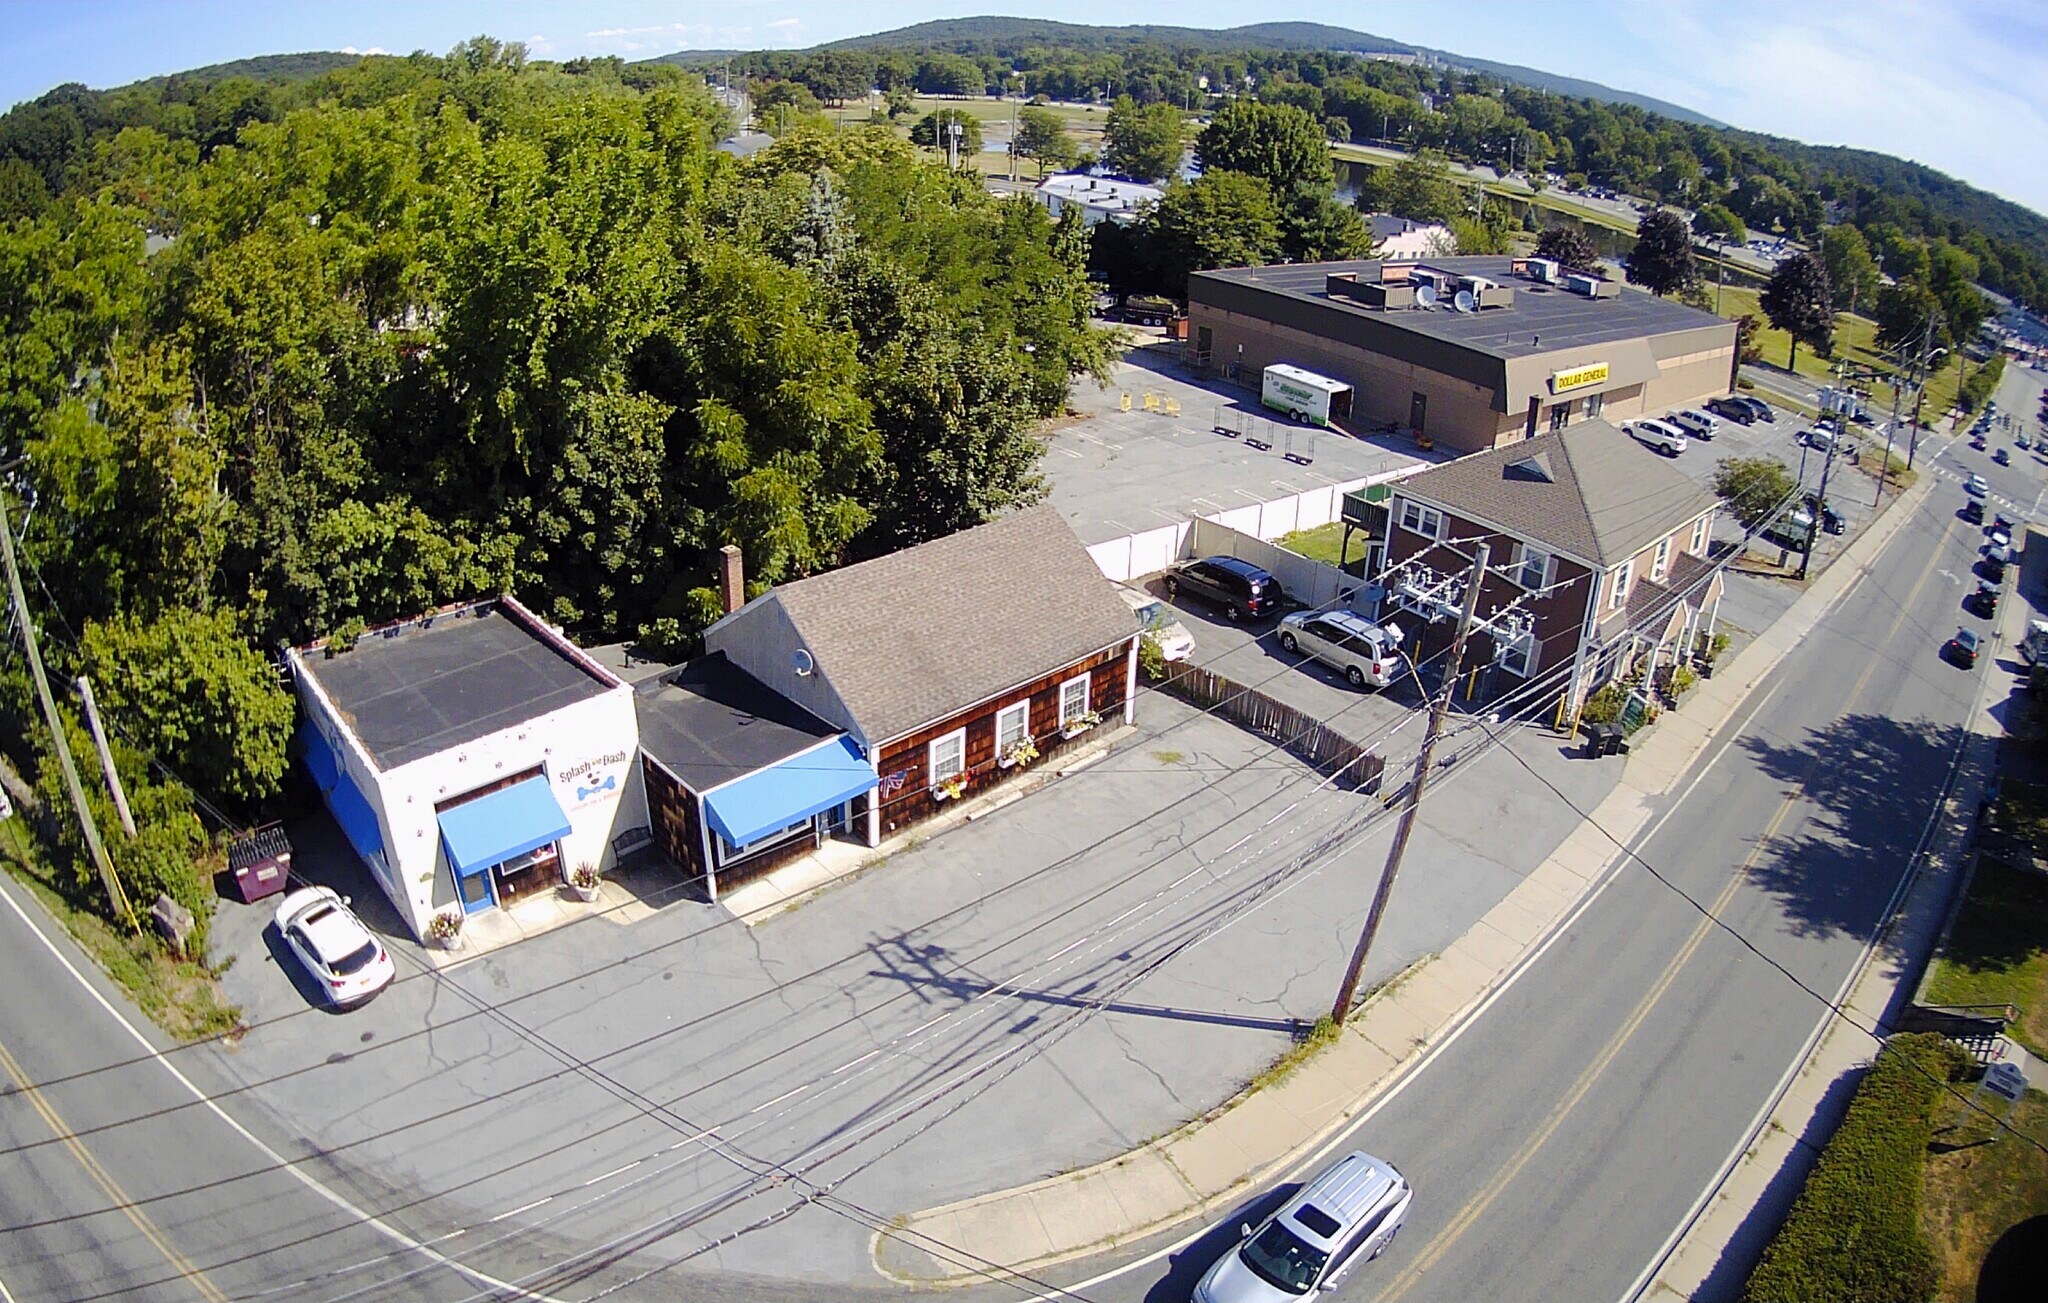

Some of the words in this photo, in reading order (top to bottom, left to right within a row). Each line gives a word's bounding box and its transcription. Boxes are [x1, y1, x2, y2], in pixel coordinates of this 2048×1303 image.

[1559, 374, 1581, 388] DOLLAR
[1583, 368, 1606, 382] GENERAL
[560, 762, 591, 783] Splash
[603, 750, 626, 766] Dash
